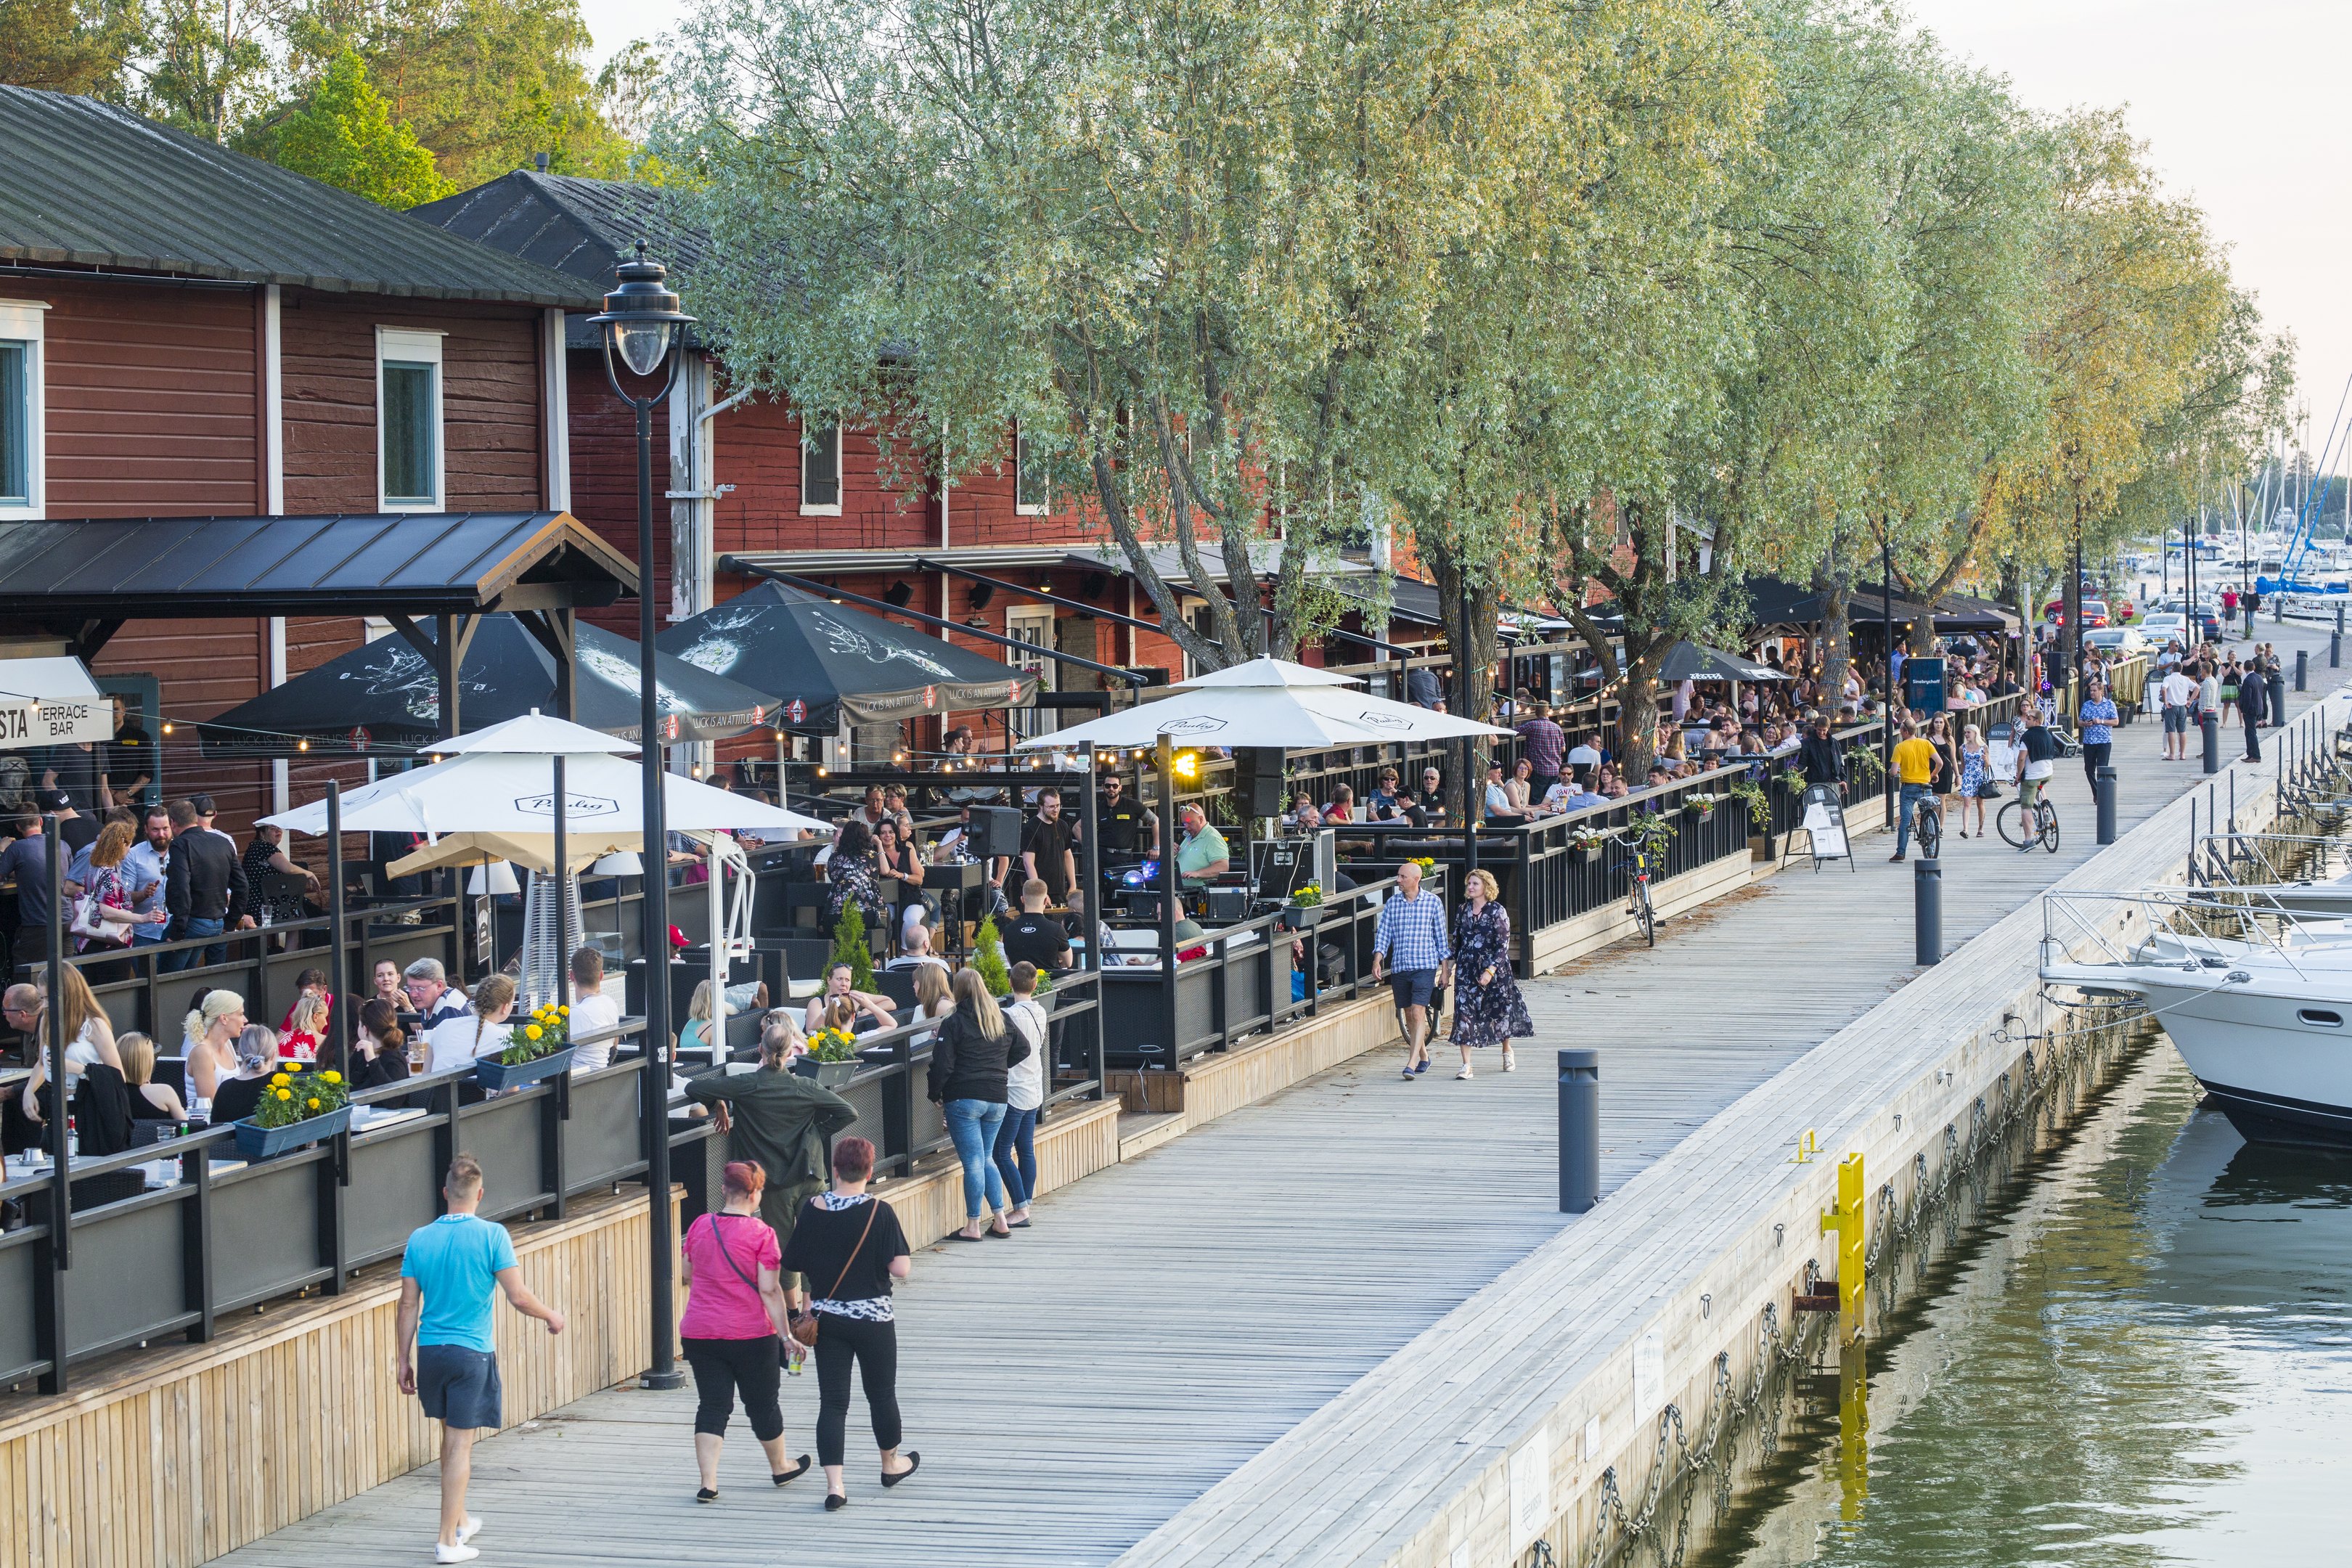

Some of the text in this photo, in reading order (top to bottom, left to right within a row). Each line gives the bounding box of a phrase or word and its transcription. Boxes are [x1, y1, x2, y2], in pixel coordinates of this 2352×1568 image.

[950, 686, 1011, 699] LUCK IS AN ATTITUDE
[859, 693, 925, 714] LUCK IS AN ATTITUDE
[37, 705, 88, 721] TERRACE
[693, 713, 755, 728] LUCK IS AN ATTITUDE
[1169, 721, 1214, 730] Paulig
[50, 722, 73, 735] BAR
[232, 734, 352, 746] LUCK IS AN ATITUDE
[400, 734, 428, 746] LUCK
